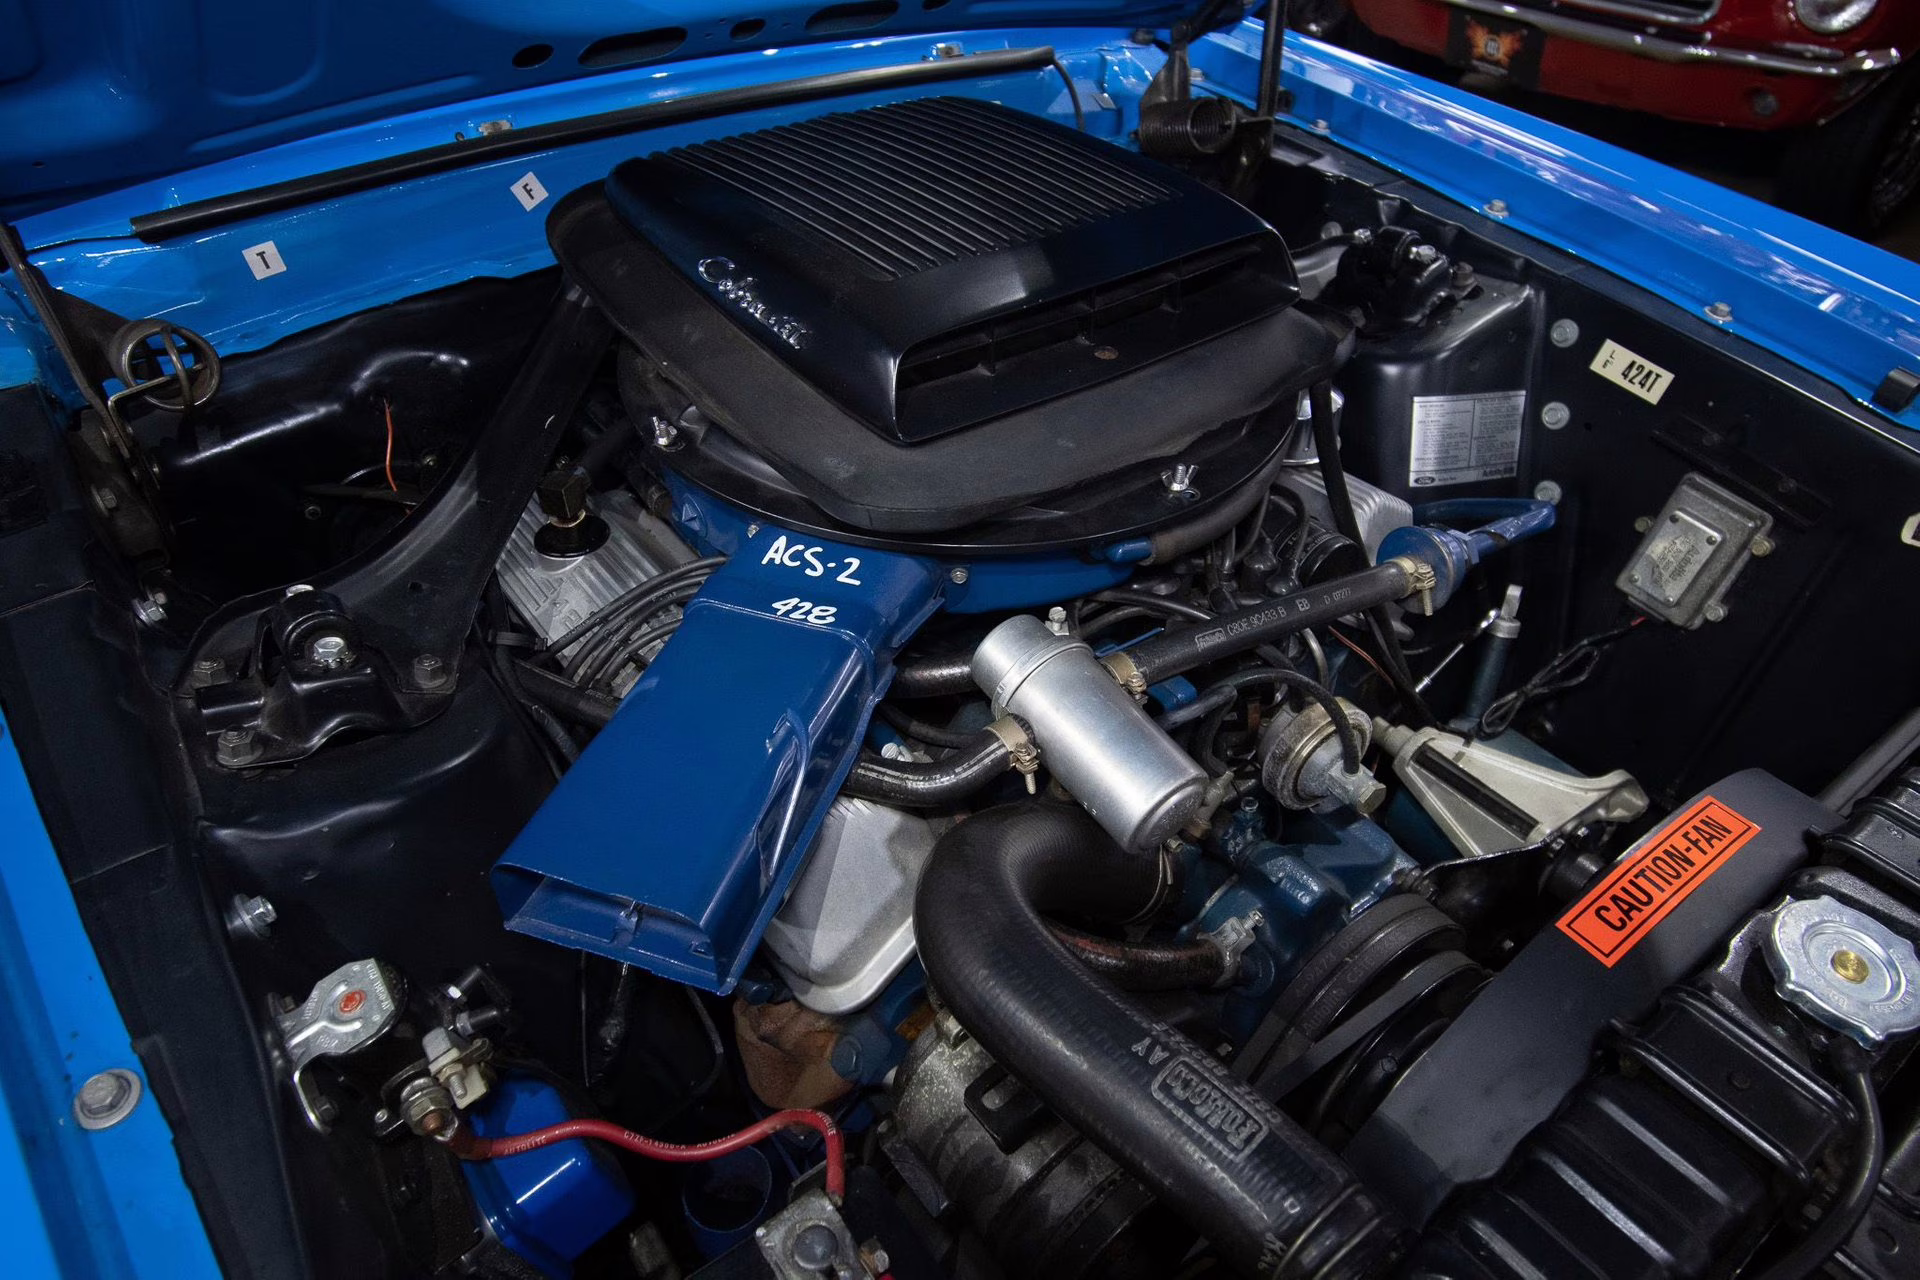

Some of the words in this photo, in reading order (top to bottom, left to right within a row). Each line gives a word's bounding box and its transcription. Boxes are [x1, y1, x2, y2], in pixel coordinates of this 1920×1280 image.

[521, 182, 535, 200] F
[255, 250, 271, 270] T
[1621, 359, 1663, 393] 424T
[761, 535, 861, 586] ACS-2
[771, 597, 838, 625] 428
[1594, 815, 1733, 932] CAUTION-FAN
